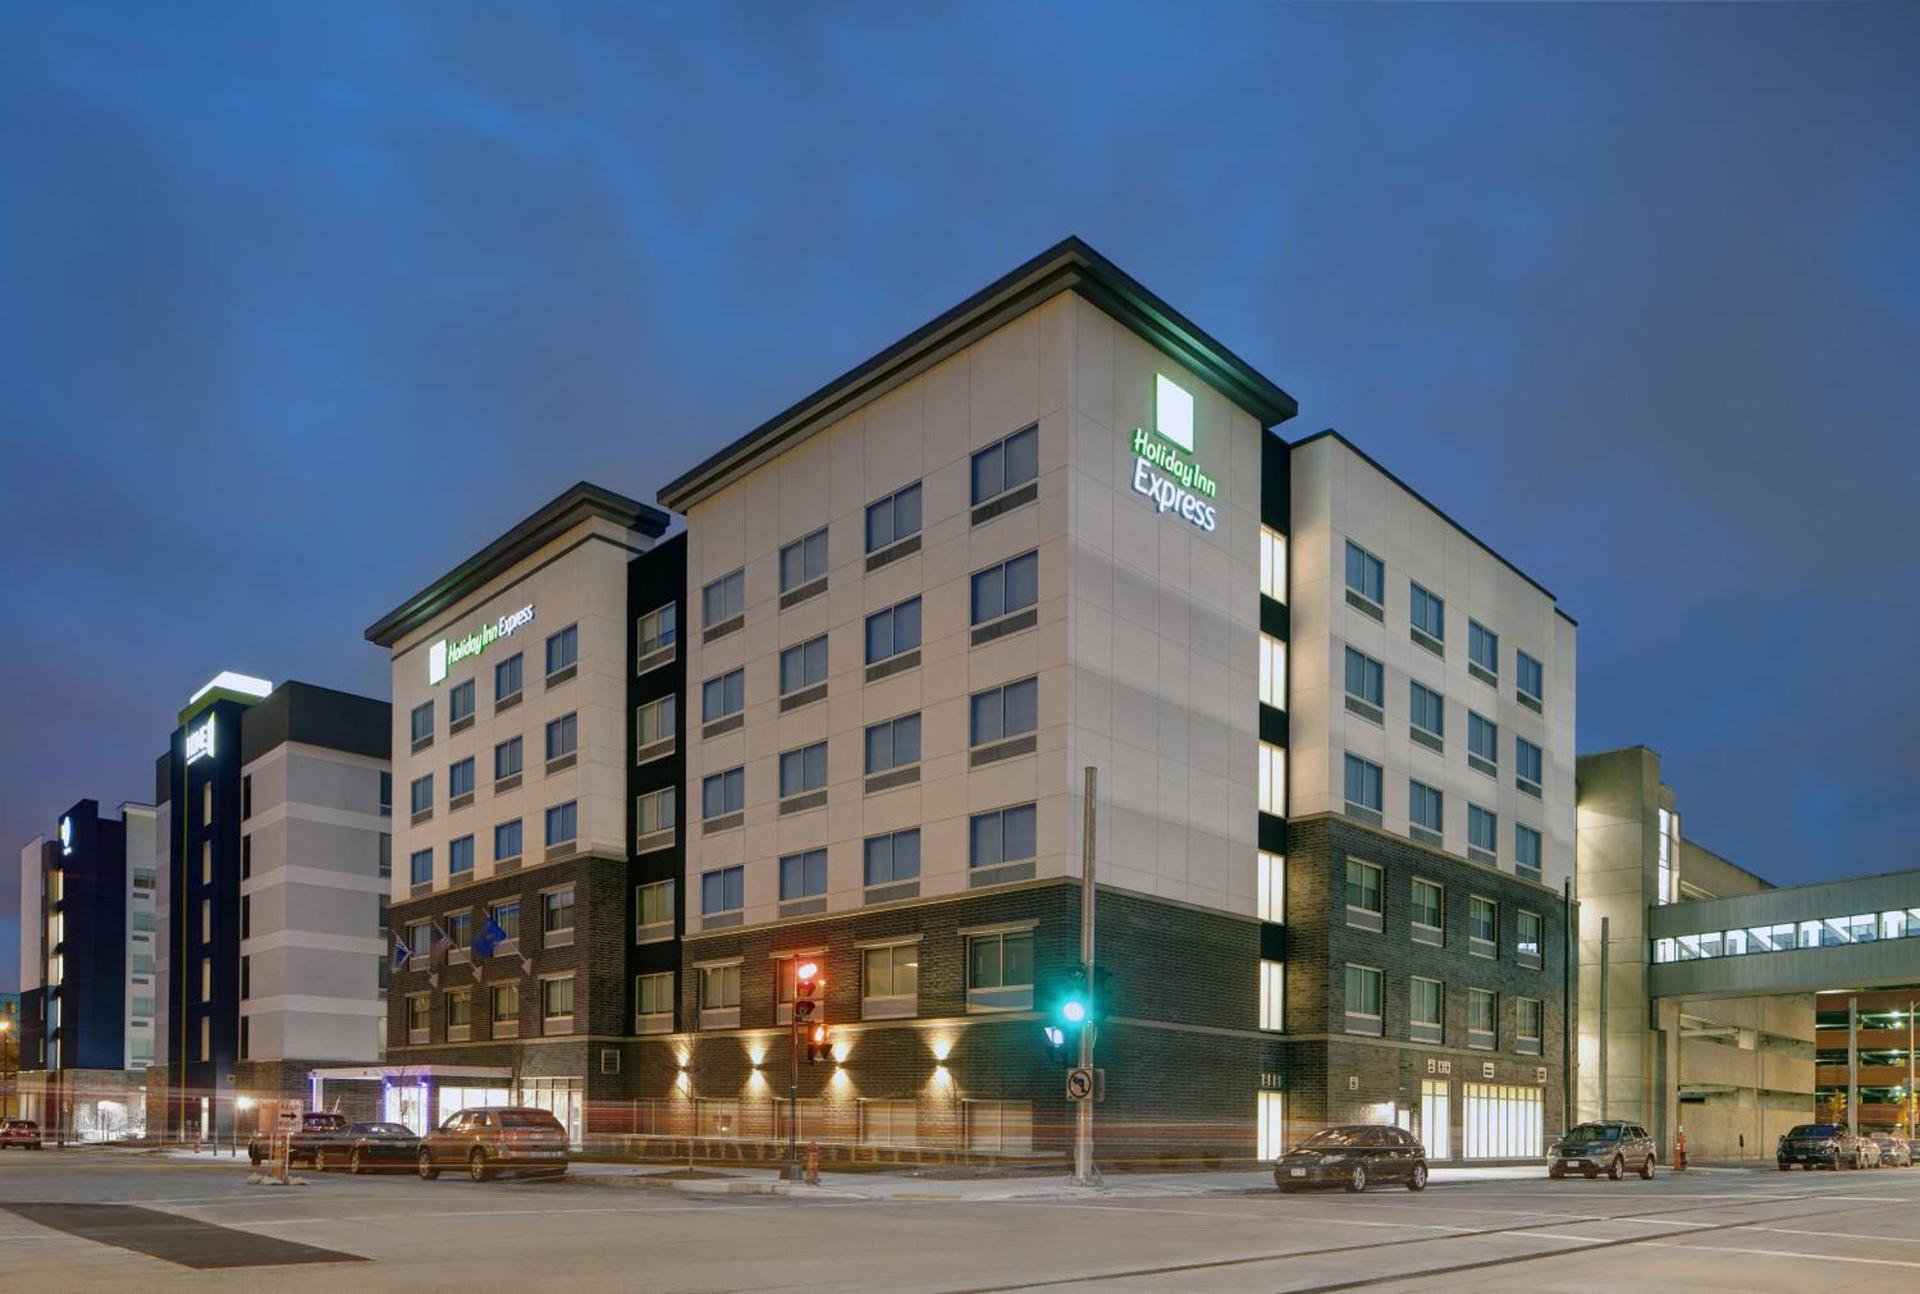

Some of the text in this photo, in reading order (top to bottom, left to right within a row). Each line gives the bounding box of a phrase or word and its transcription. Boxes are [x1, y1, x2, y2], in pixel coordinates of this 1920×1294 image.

[1134, 457, 1216, 530] Express
[448, 604, 534, 665] Holiday Inn Express
